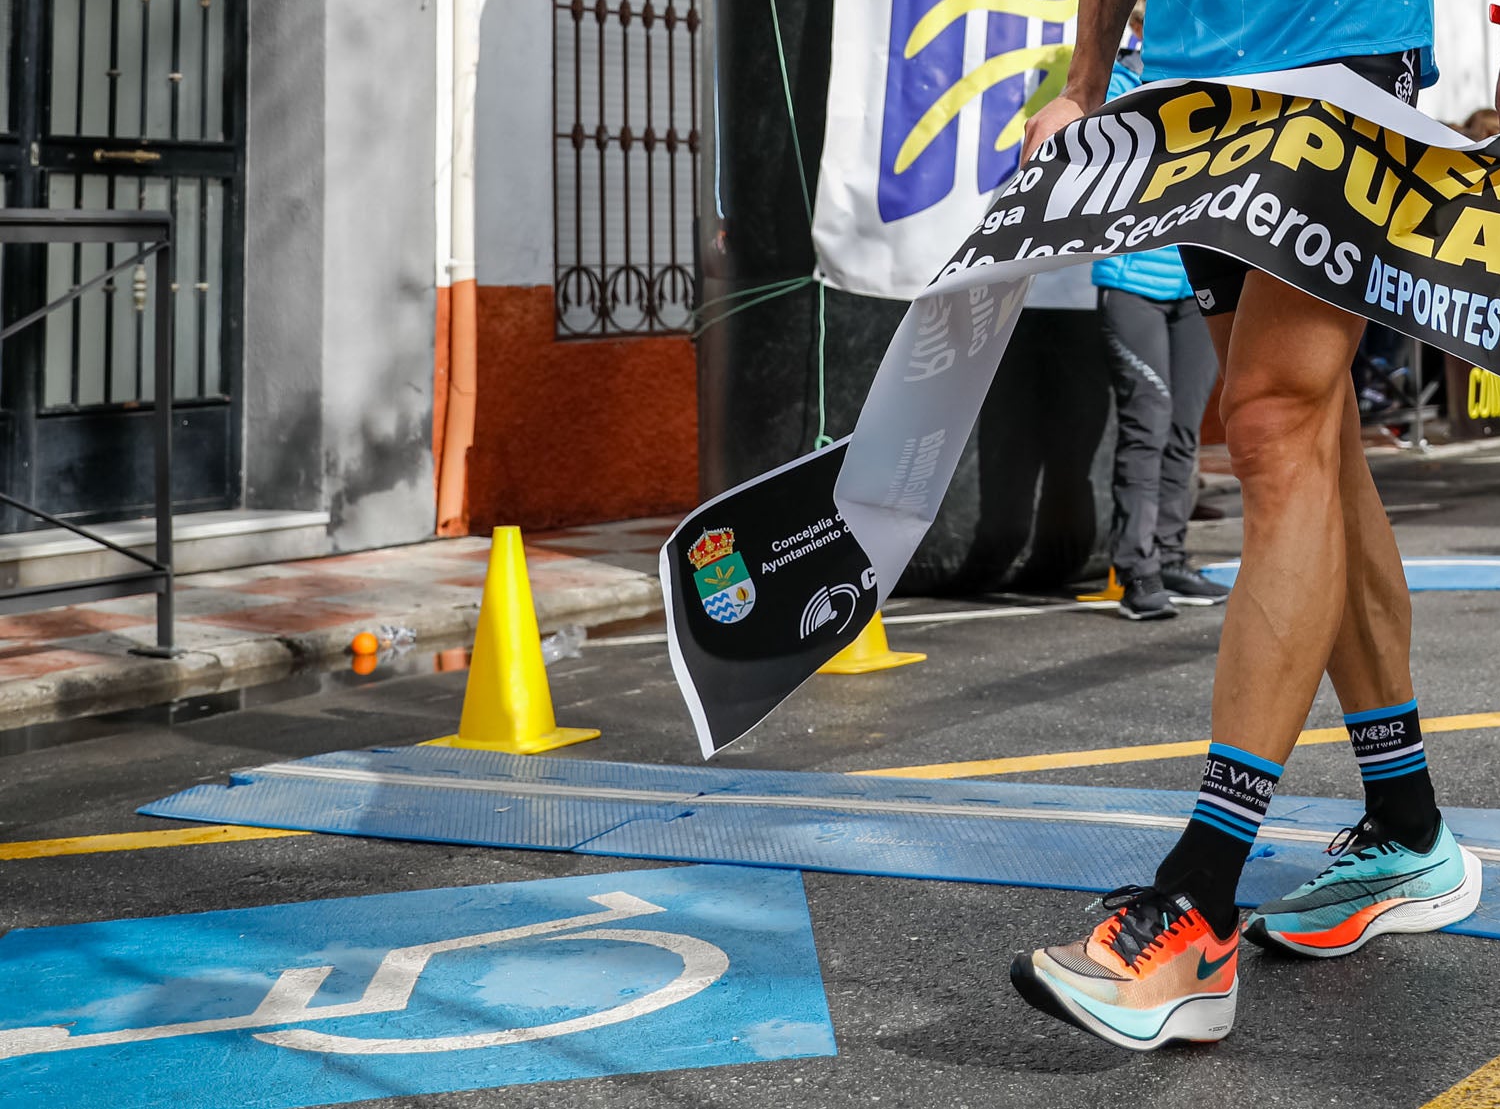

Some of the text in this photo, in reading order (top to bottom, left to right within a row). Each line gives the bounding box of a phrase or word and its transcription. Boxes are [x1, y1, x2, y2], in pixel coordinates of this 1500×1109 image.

[1093, 173, 1362, 285] Secaderos
[761, 529, 842, 575] Ayuntamiento
[771, 517, 834, 552] Concejalía
